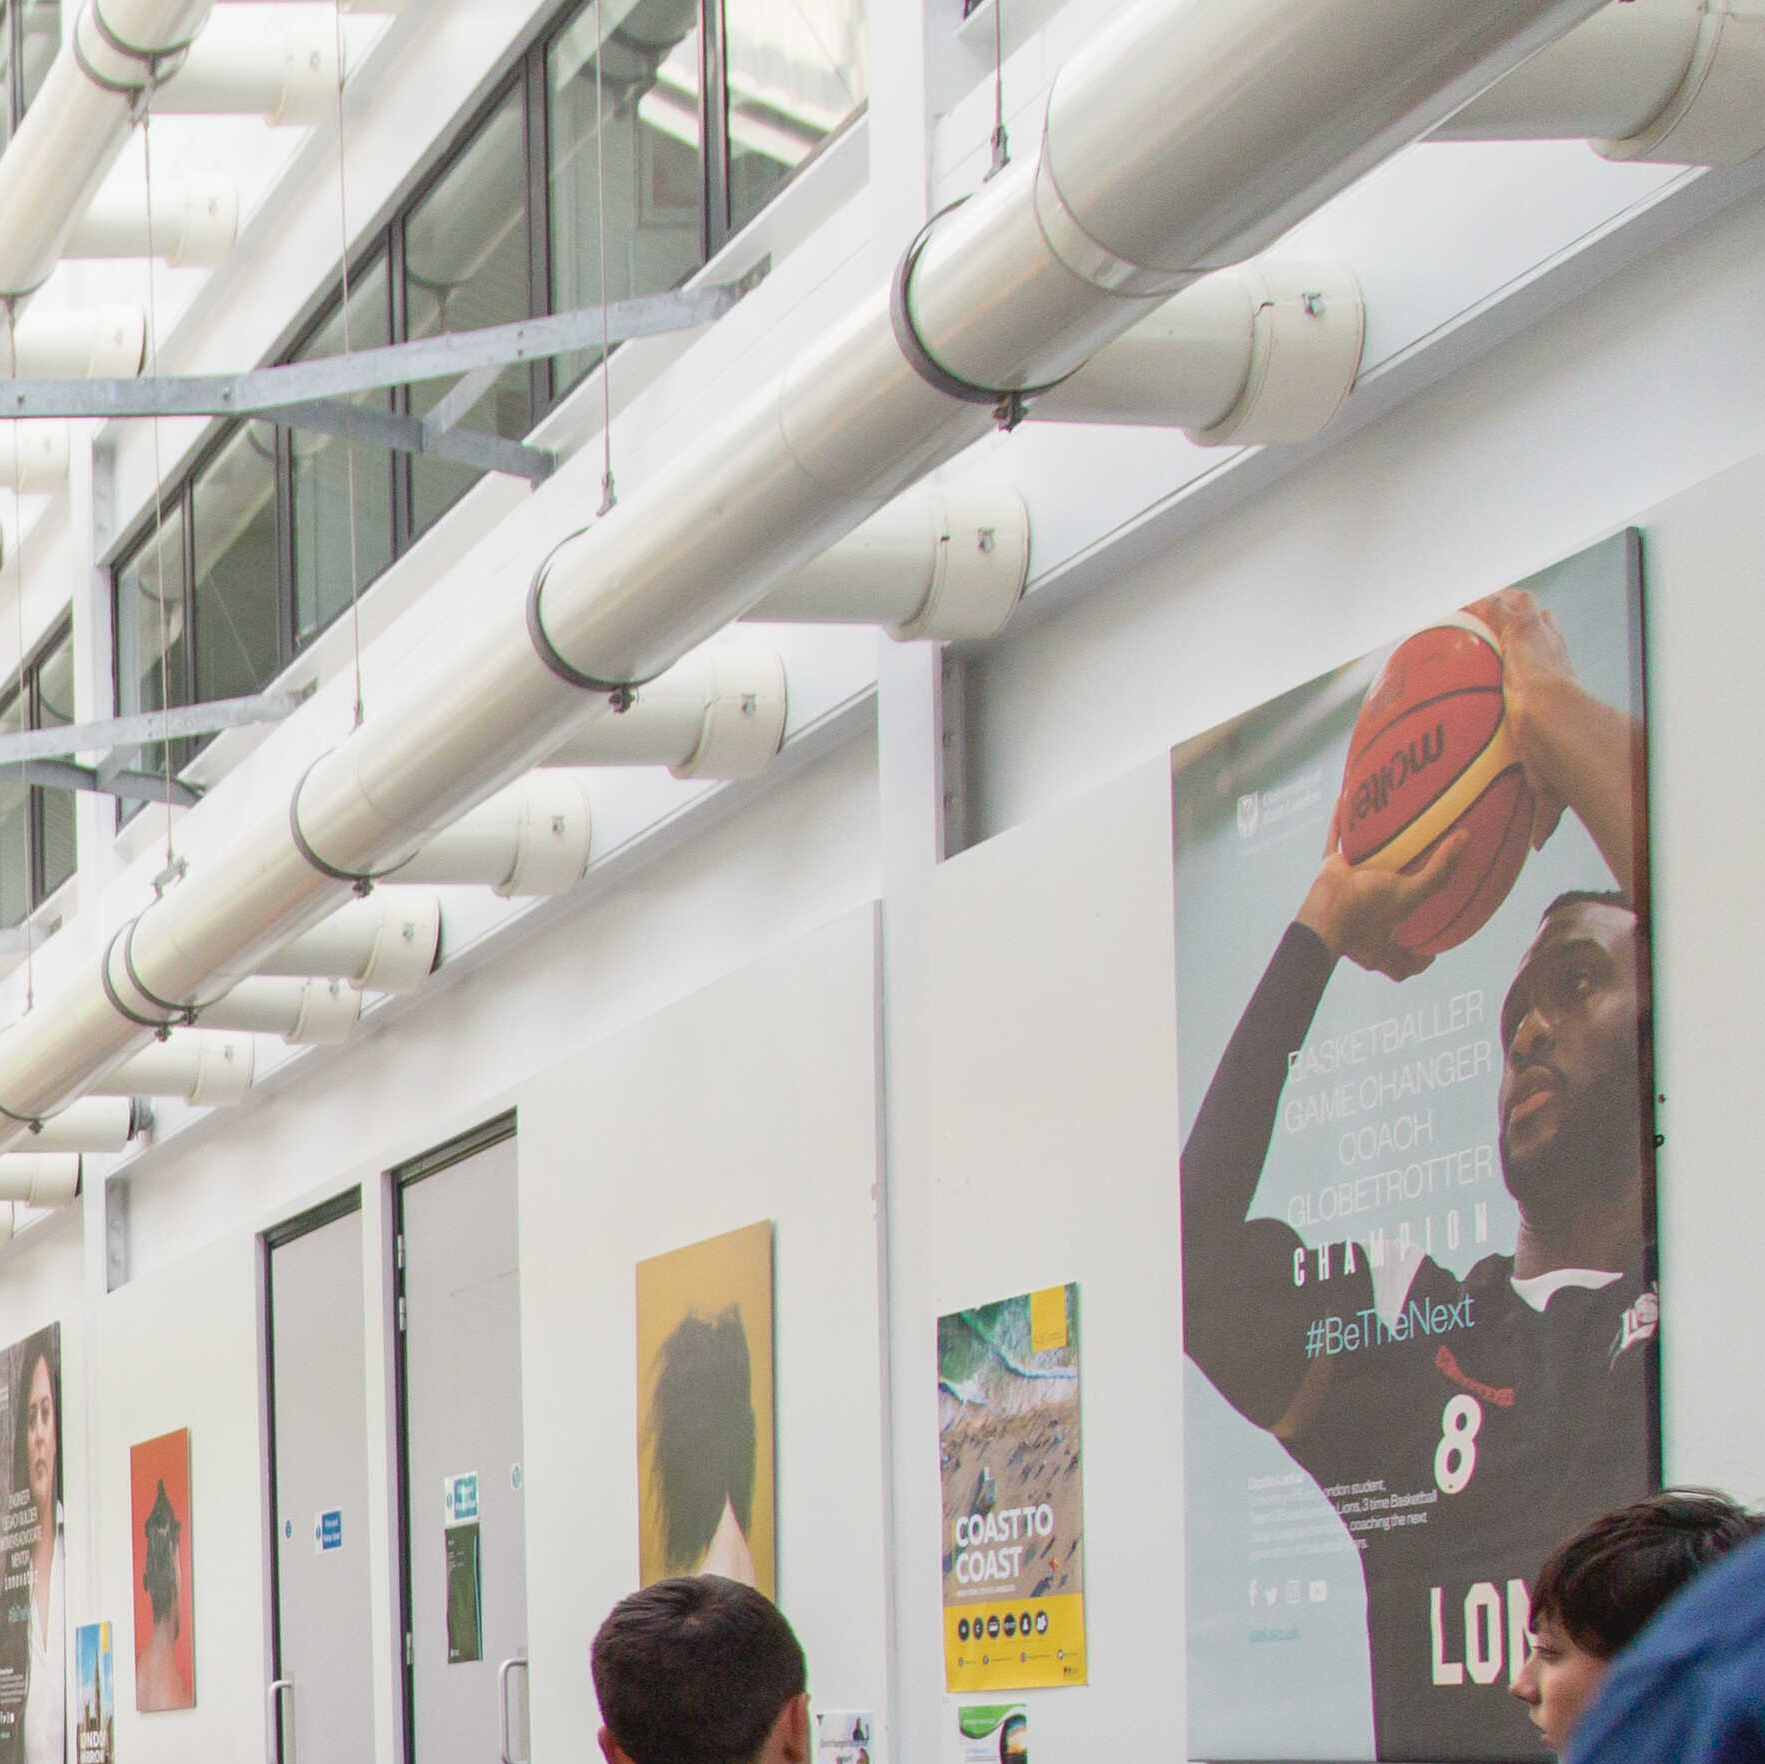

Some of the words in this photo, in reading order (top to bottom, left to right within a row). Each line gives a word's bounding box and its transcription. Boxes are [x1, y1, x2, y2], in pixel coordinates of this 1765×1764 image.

[1288, 989, 1486, 1083] BASKETBALLER
[1284, 1081, 1357, 1133] GAME
[1359, 1040, 1493, 1111] CHANGER
[1338, 1109, 1434, 1166] COACH
[1287, 1144, 1494, 1228] GLOBETROTTER
[1293, 1202, 1488, 1288] CHAMPION
[1305, 1294, 1476, 1359] #BeTheNext
[1434, 1394, 1483, 1494] 8
[955, 1508, 1022, 1548] COAST
[1021, 1503, 1054, 1538] TO
[956, 1546, 1023, 1584] COAST
